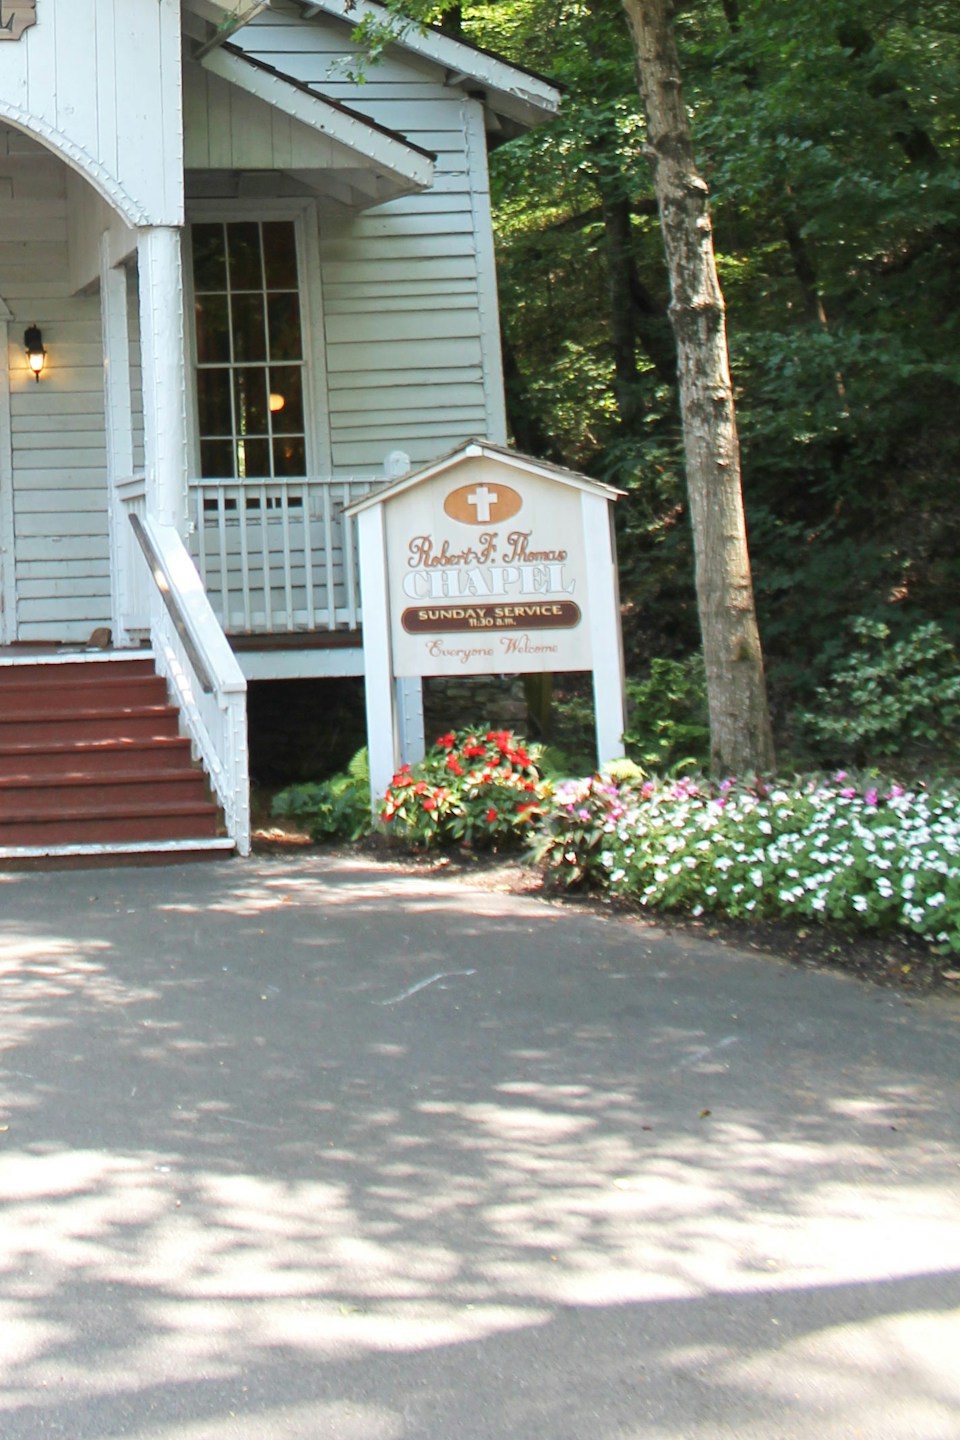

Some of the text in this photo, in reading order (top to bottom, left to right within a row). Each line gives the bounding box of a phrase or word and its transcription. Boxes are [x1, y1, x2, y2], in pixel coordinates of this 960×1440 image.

[407, 530, 568, 569] Robert F. Thomas
[401, 563, 576, 600] CHAPEL
[418, 605, 563, 621] SUNDAY SERVICE
[468, 617, 516, 628] 11:30 a.m.
[425, 634, 558, 664] Everyone Welcome
